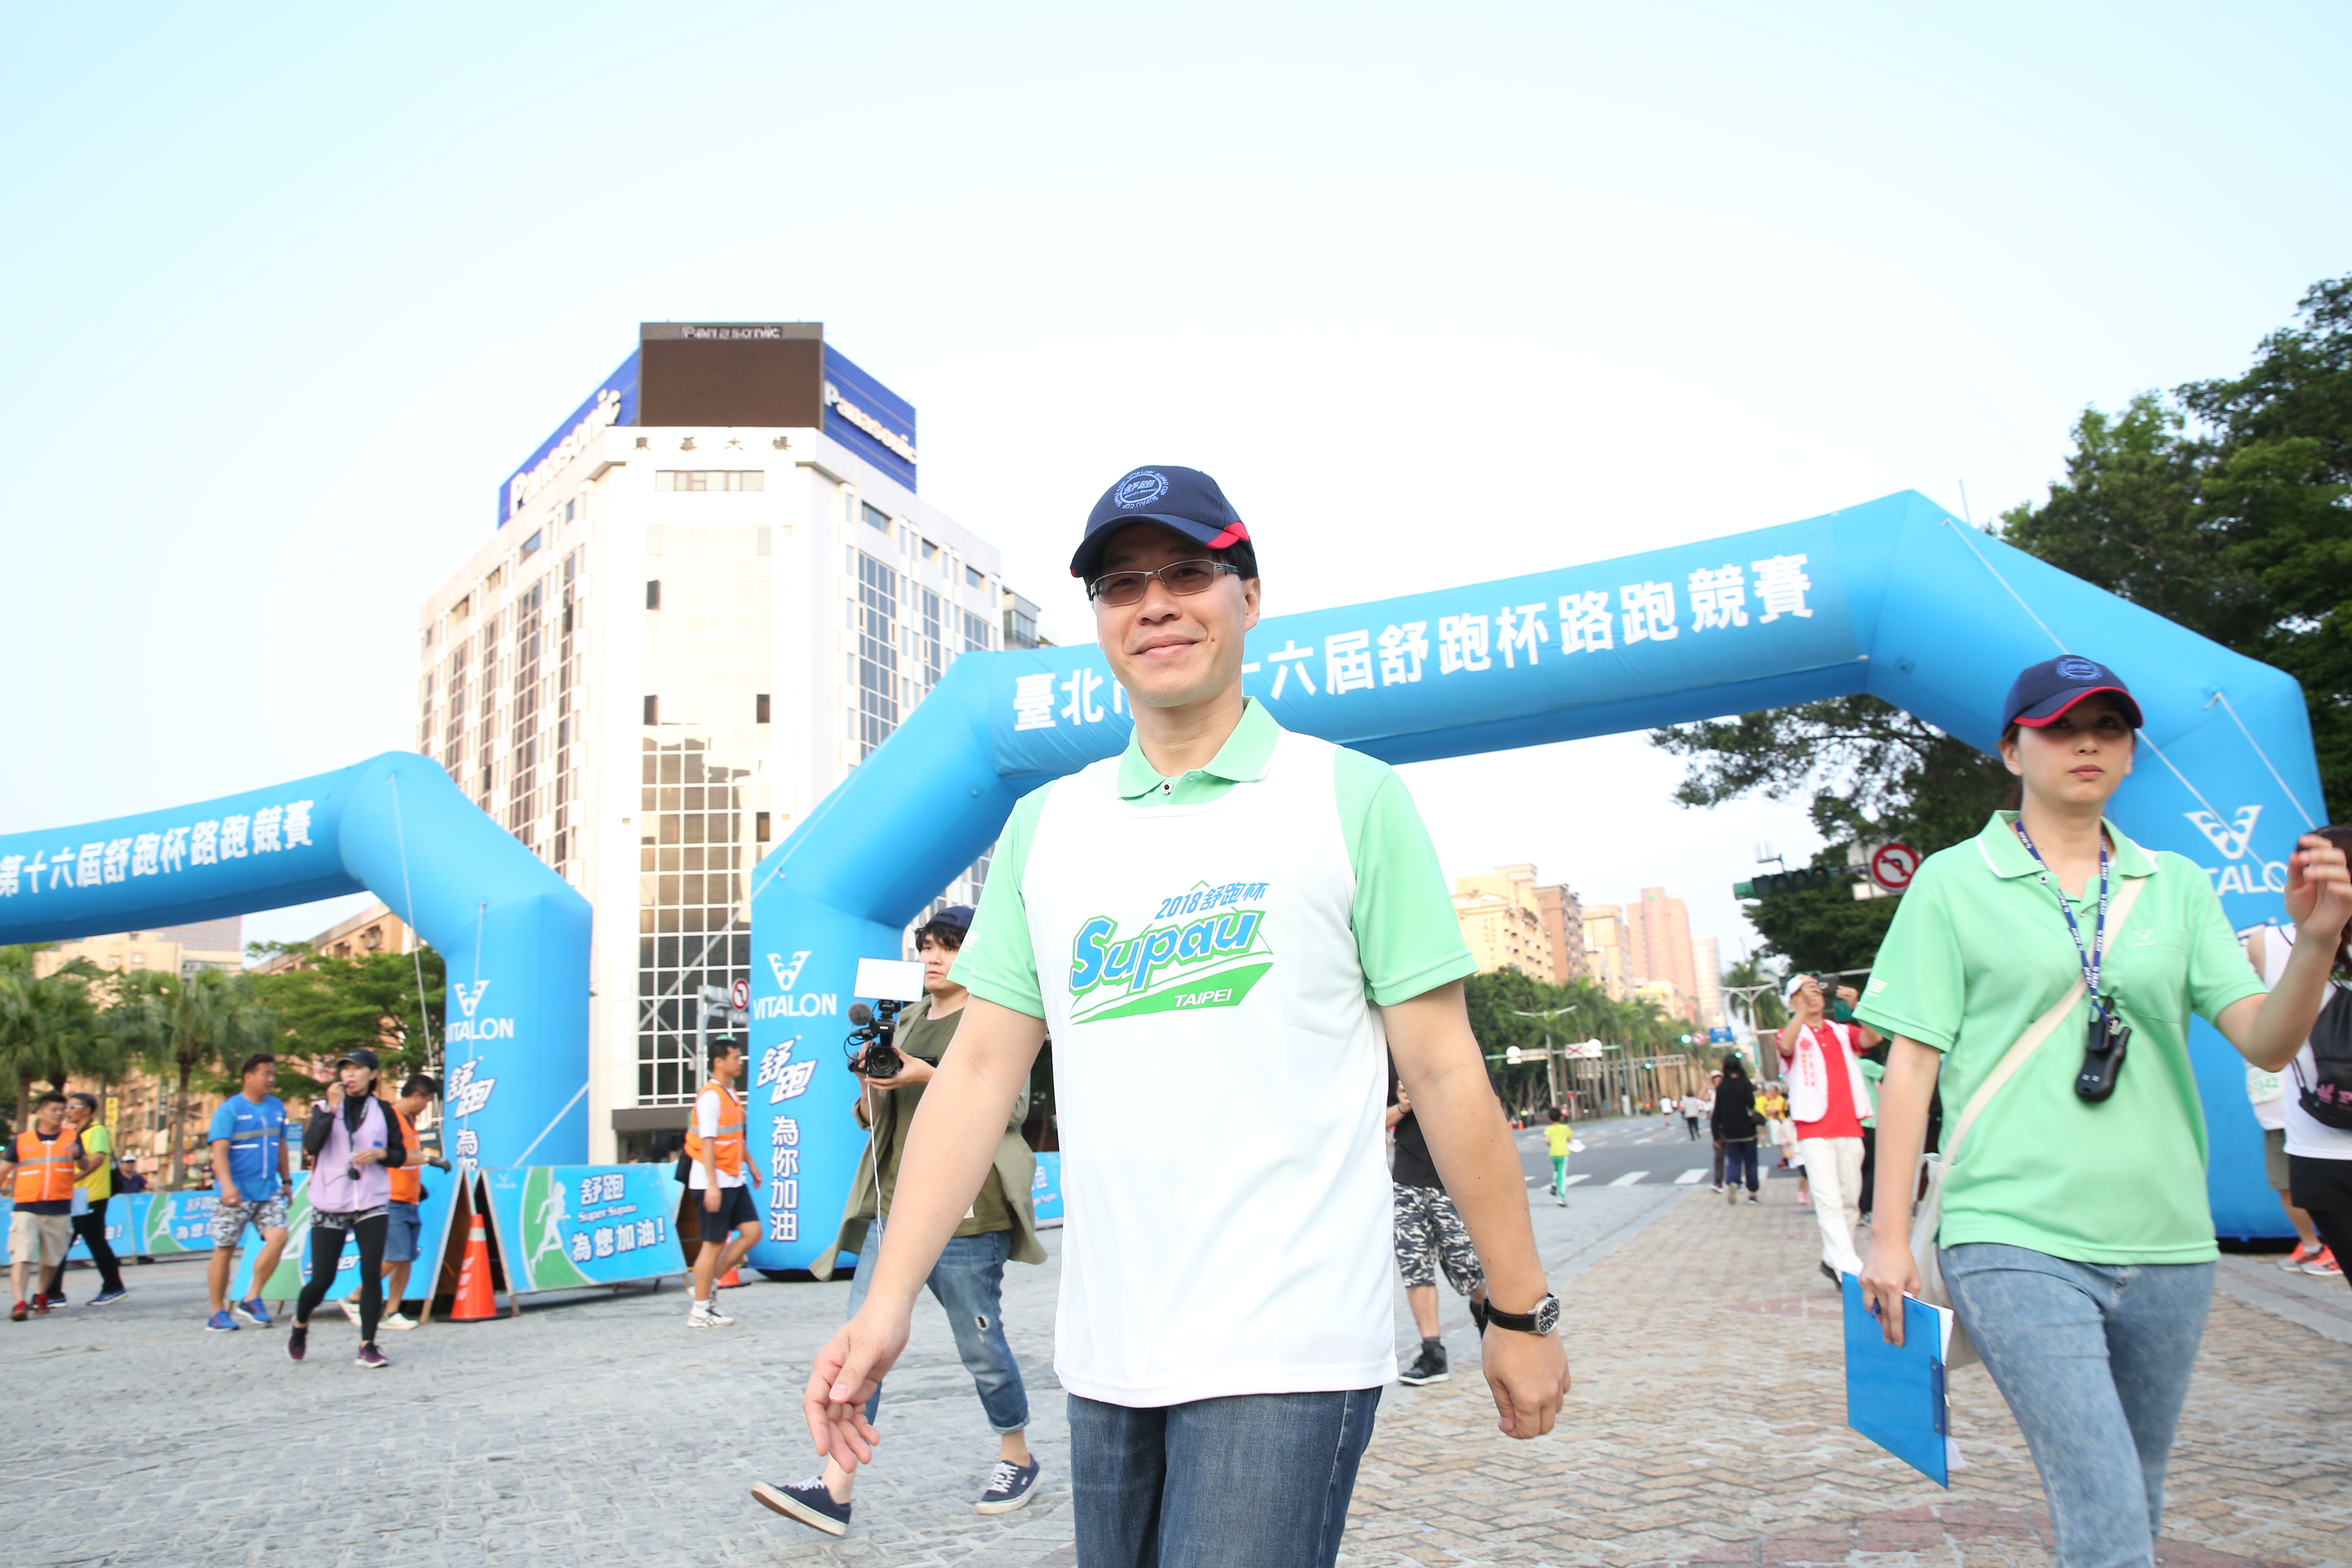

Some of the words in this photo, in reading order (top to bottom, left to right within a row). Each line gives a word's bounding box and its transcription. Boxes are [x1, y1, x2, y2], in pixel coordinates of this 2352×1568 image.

[510, 388, 621, 519] Panasonic
[824, 380, 916, 465] Panasonic
[1071, 911, 1261, 993] Supau
[753, 992, 837, 1020] VITALON
[1174, 988, 1233, 1008] TAIPEI
[446, 1059, 496, 1119] 舒跑
[756, 1039, 818, 1106] 舒跑
[579, 1174, 624, 1205] 舒跑
[770, 1115, 800, 1241] 為你加油
[572, 1216, 666, 1263] 為您加油!
